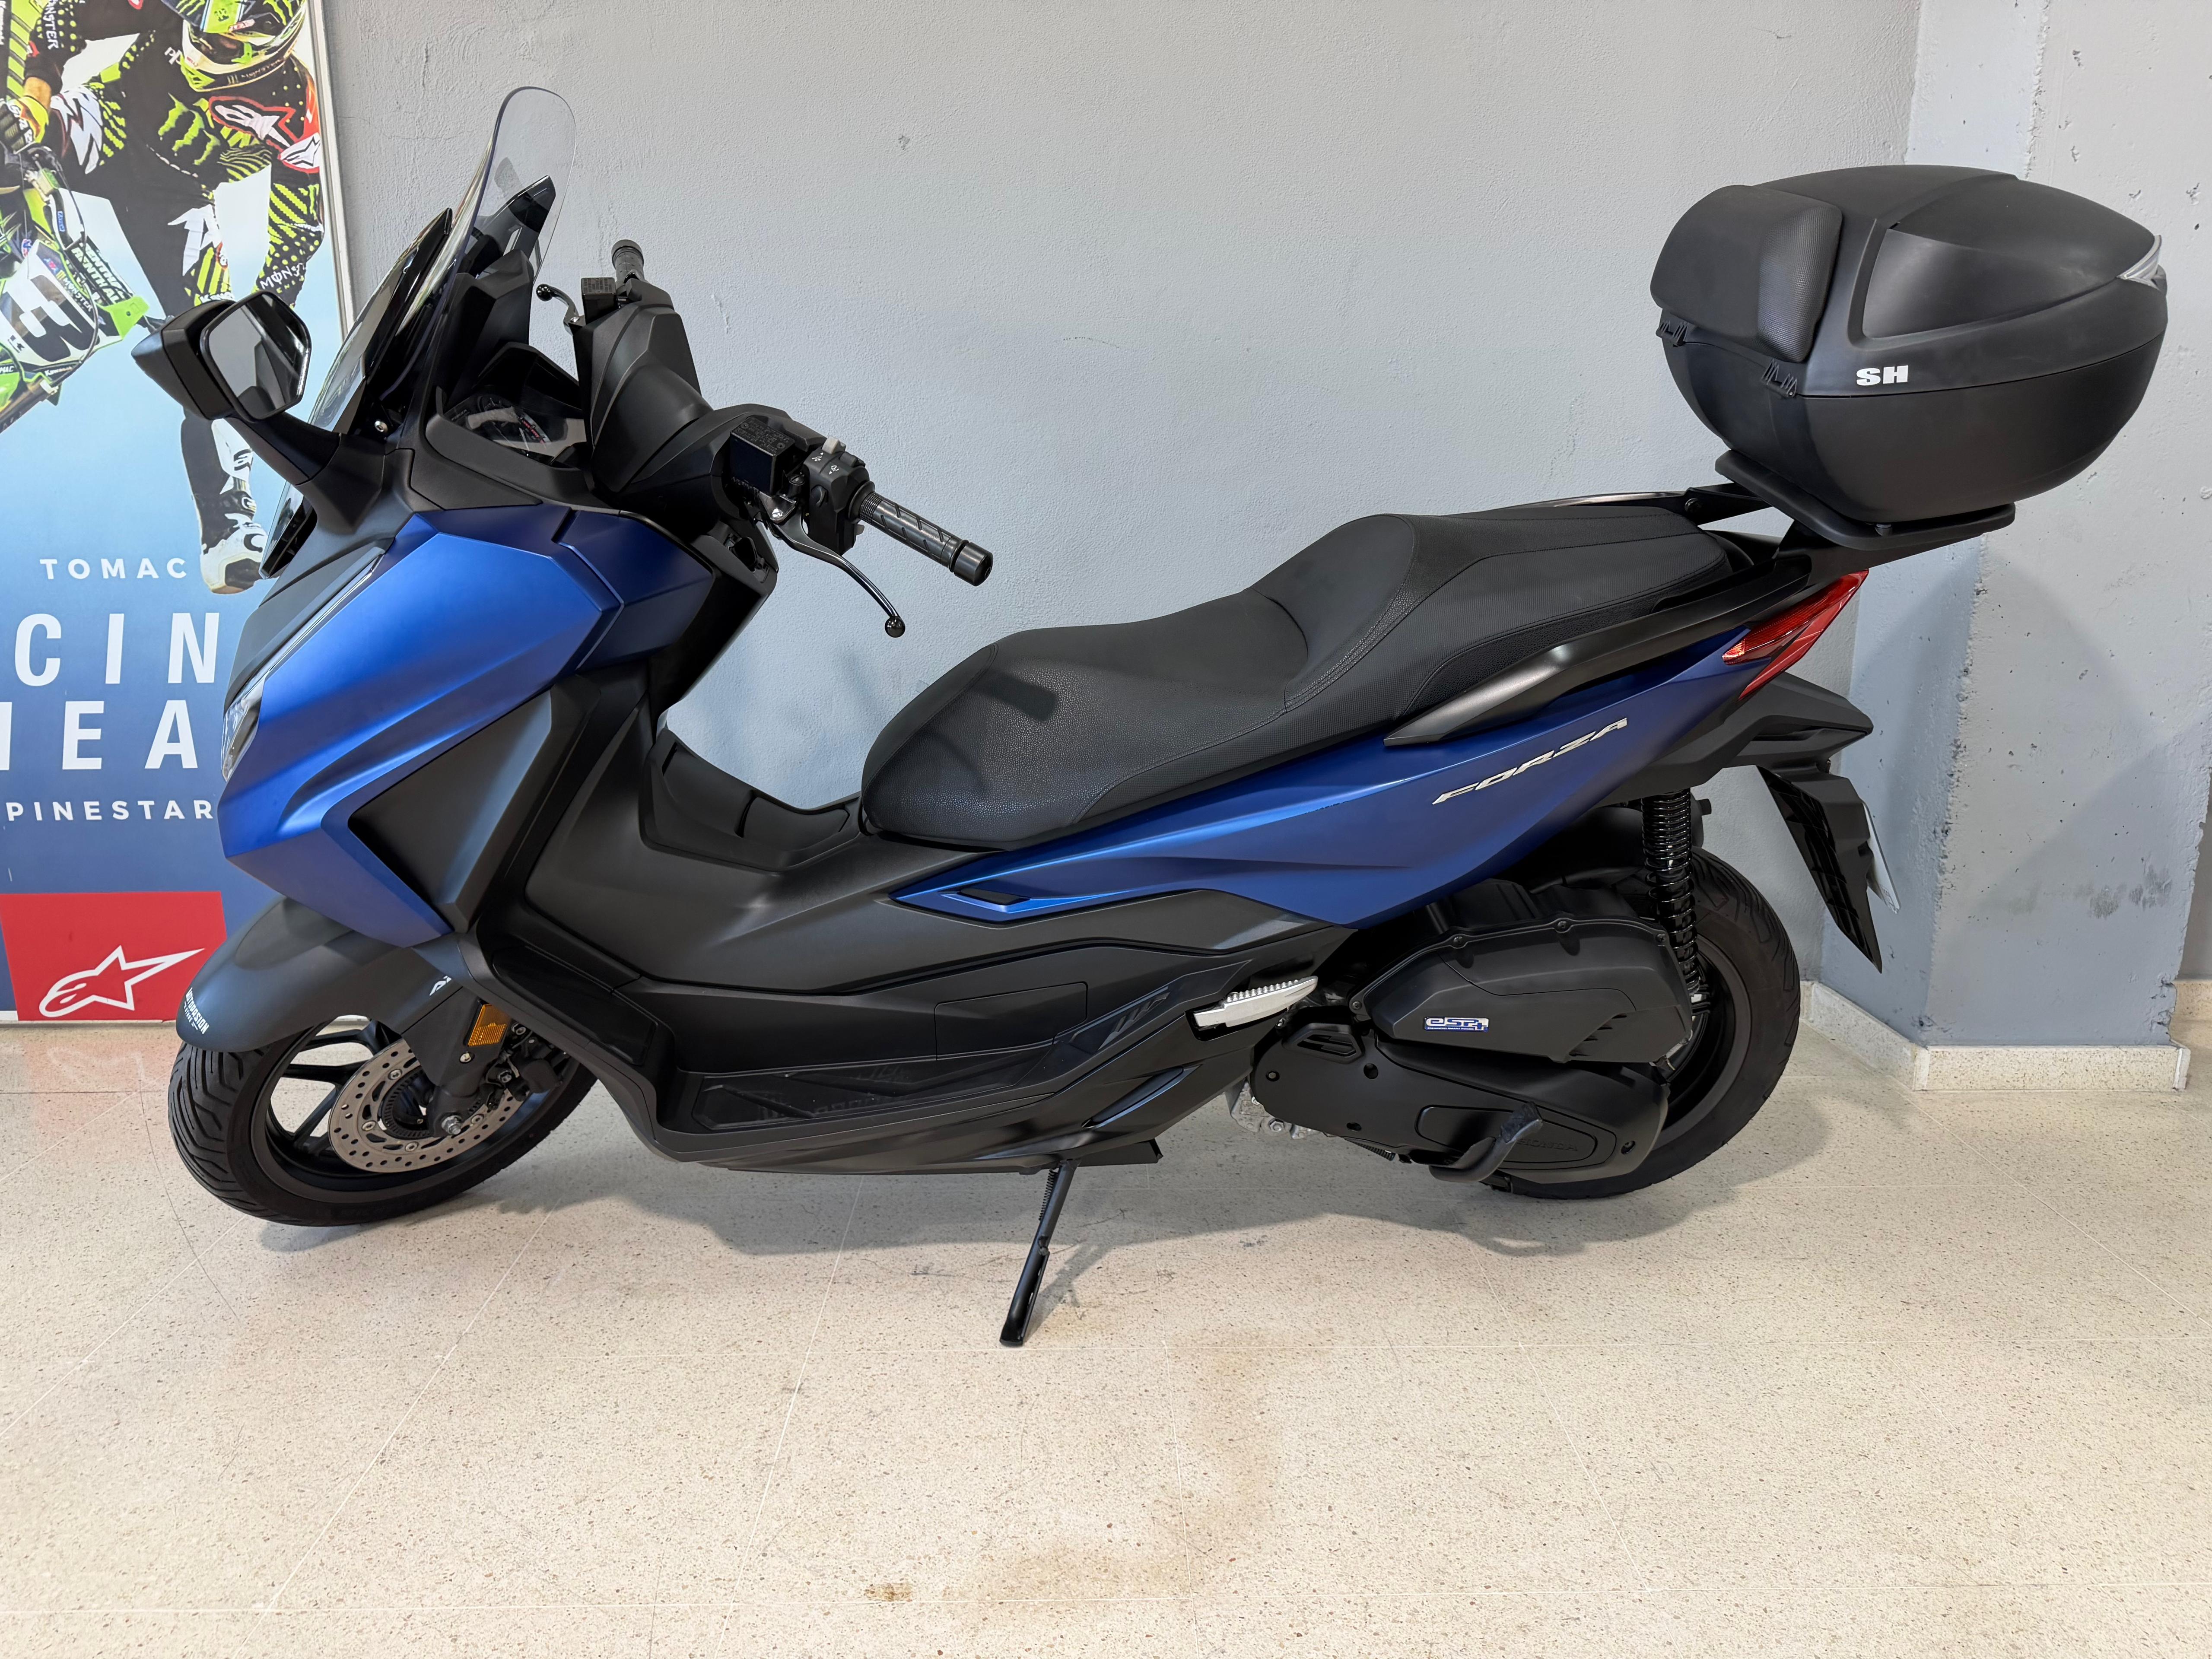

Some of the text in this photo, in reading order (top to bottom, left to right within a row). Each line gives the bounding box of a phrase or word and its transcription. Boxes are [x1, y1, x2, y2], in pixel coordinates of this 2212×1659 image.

[1856, 365, 1909, 386] SH
[39, 557, 187, 579] TOMAC
[15, 612, 219, 686] CIN
[1432, 717, 1628, 805] FORZA
[6, 800, 214, 821] PINESTAR
